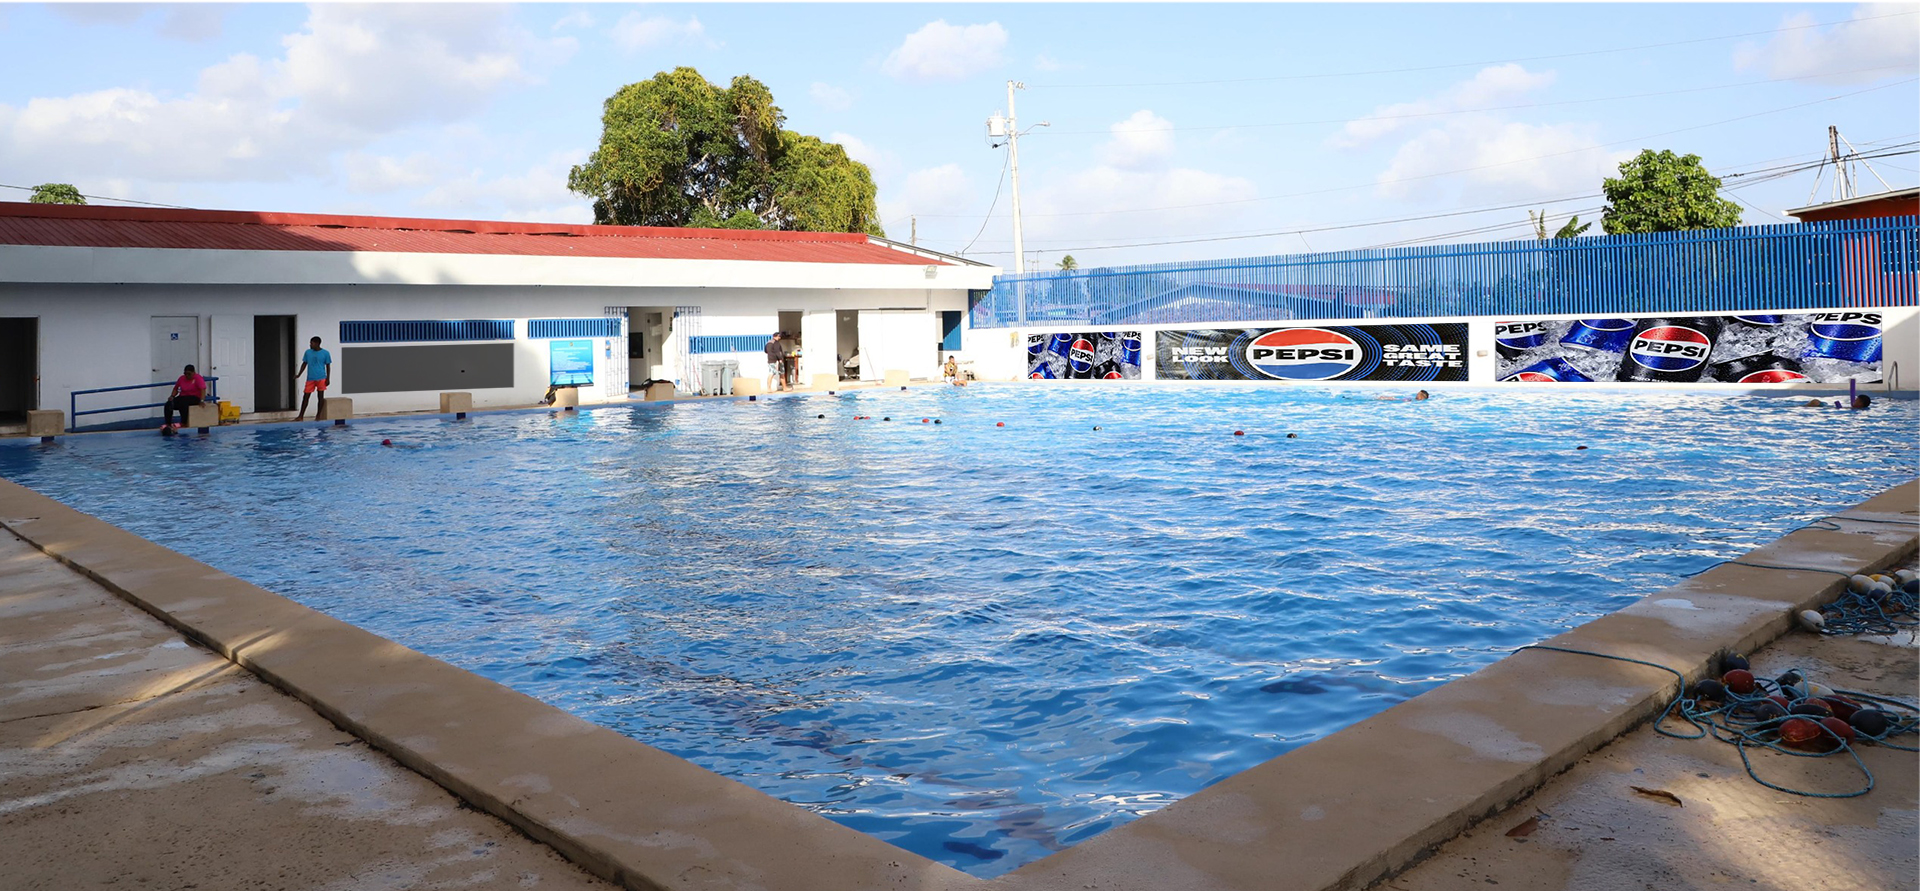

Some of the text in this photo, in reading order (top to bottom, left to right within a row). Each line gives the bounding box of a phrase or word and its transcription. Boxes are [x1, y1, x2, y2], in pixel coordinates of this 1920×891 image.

[1171, 346, 1228, 356] NEW
[1382, 344, 1460, 352] SAME
[1633, 339, 1707, 358] PEPSI
[1070, 348, 1094, 363] PEPSI
[1172, 355, 1229, 363] LOOK
[1253, 348, 1354, 361] PEPSI
[1382, 352, 1462, 360] GREAT
[1382, 359, 1463, 367] TASTE
